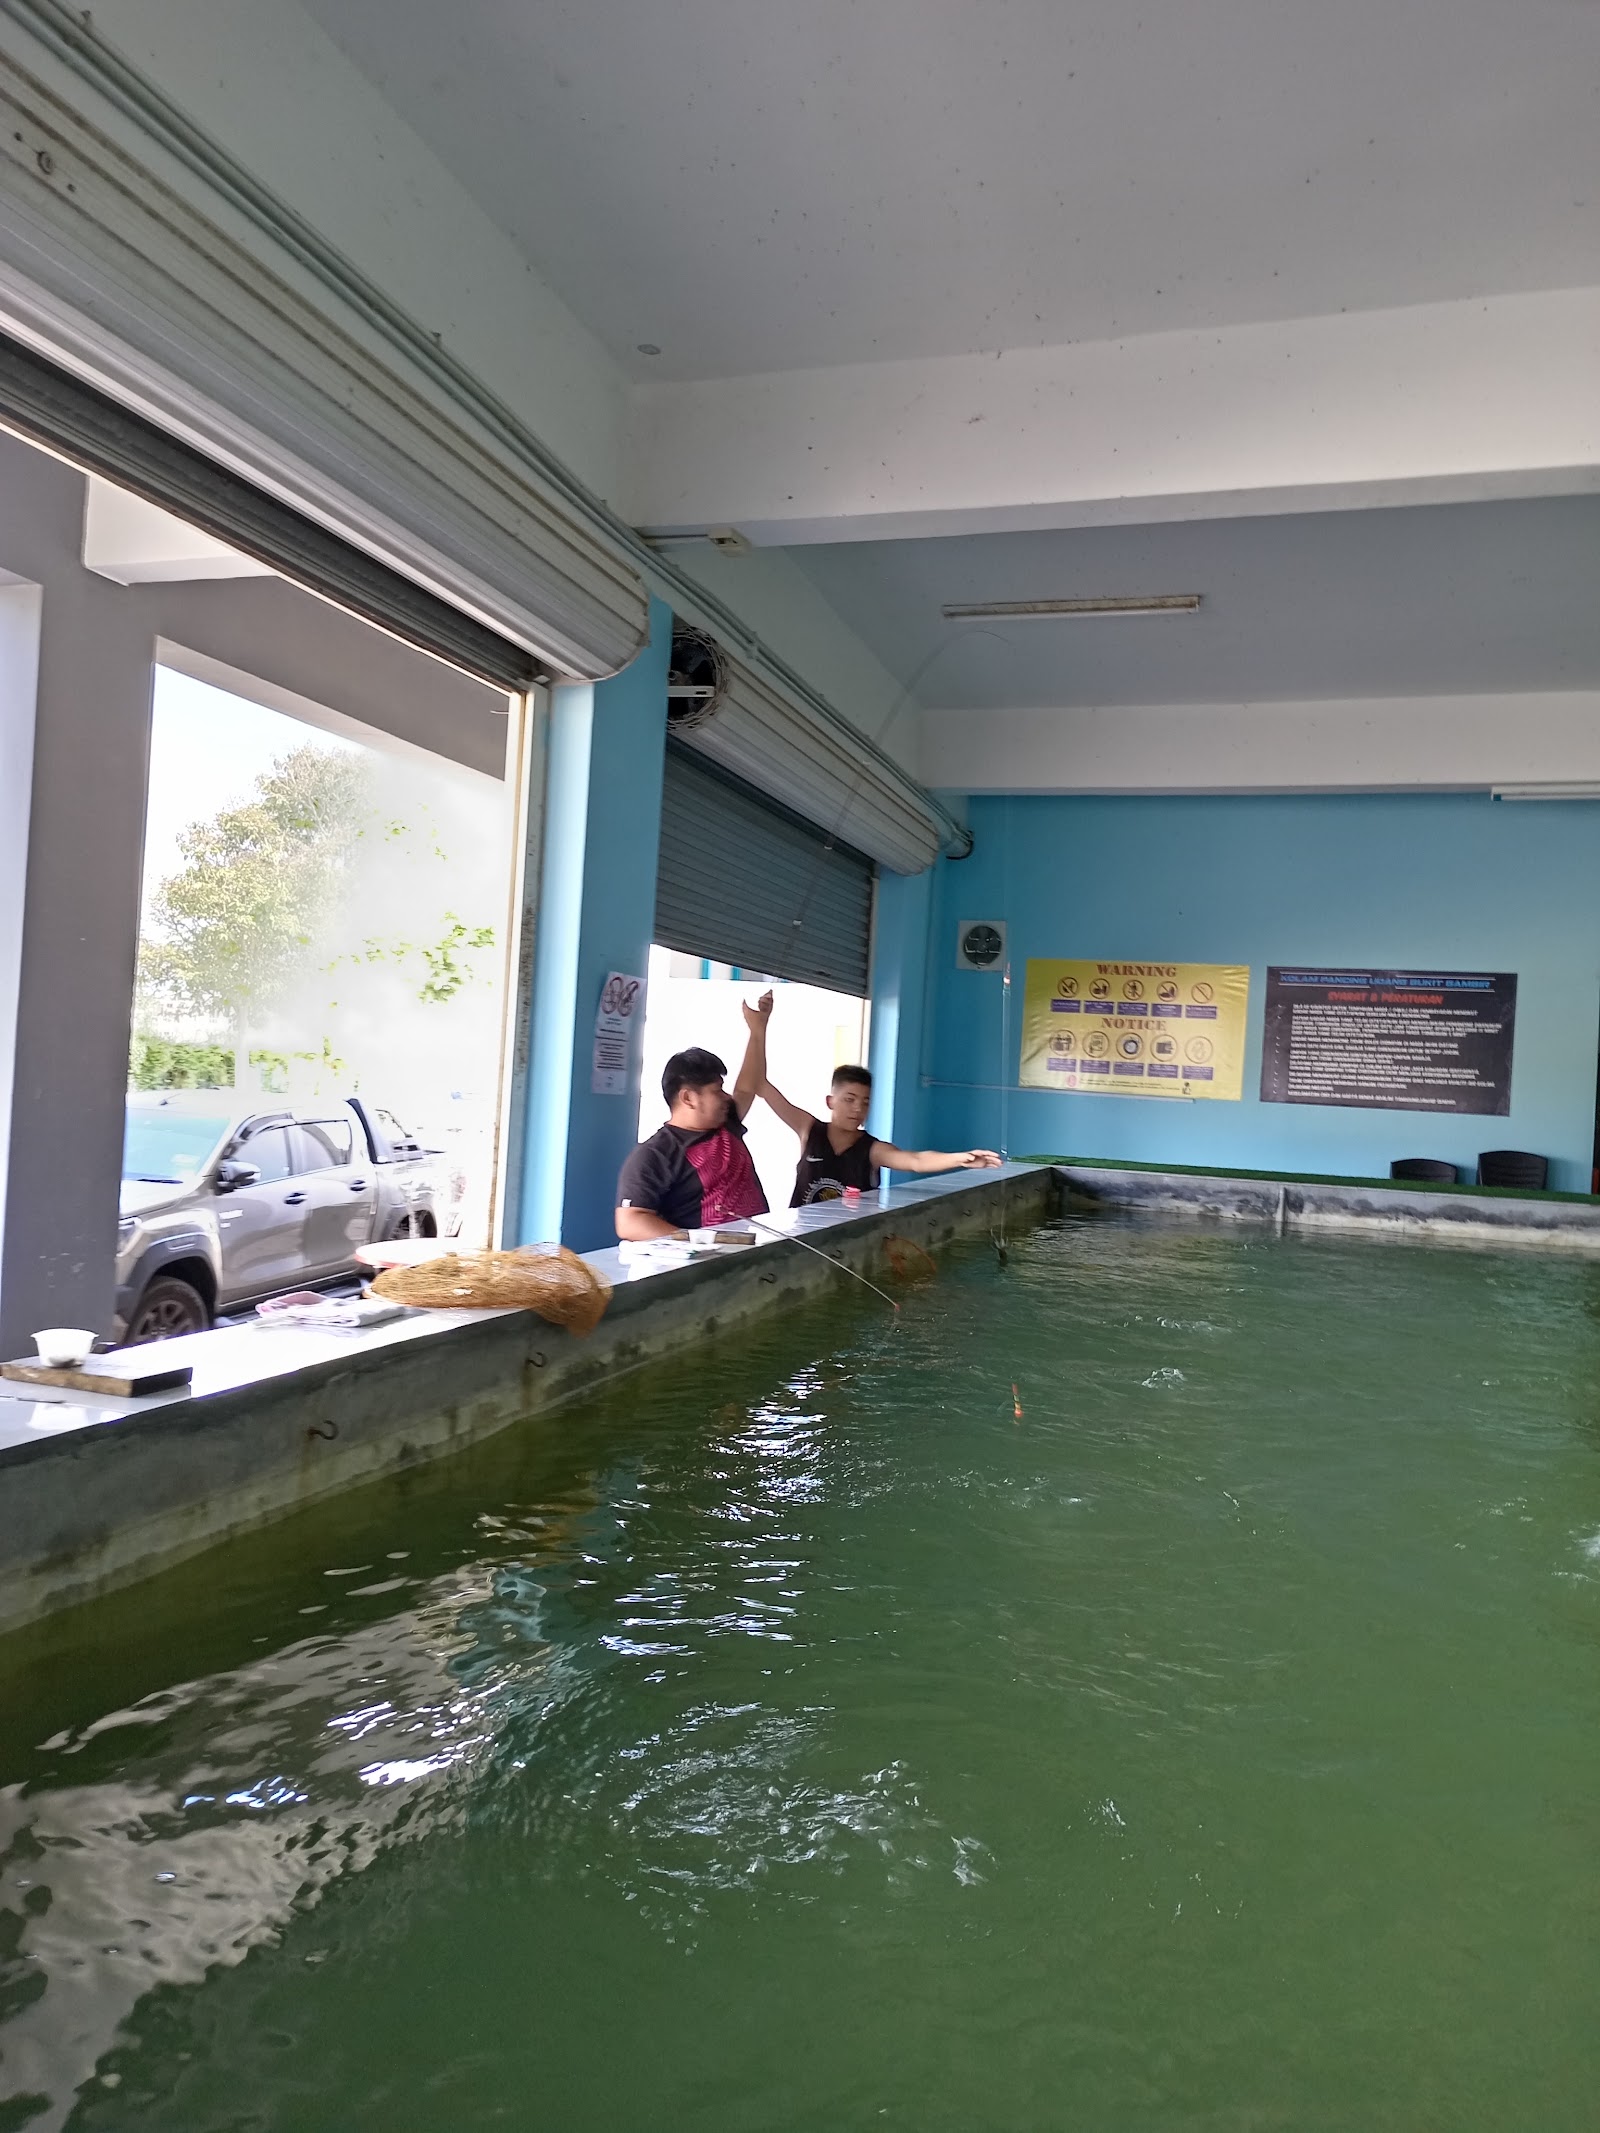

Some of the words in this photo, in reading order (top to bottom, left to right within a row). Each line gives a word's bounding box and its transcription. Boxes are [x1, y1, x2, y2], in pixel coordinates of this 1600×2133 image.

[1097, 964, 1176, 977] WARNING
[1410, 978, 1444, 987] BUKIT
[1101, 1017, 1167, 1032] NOTICE
